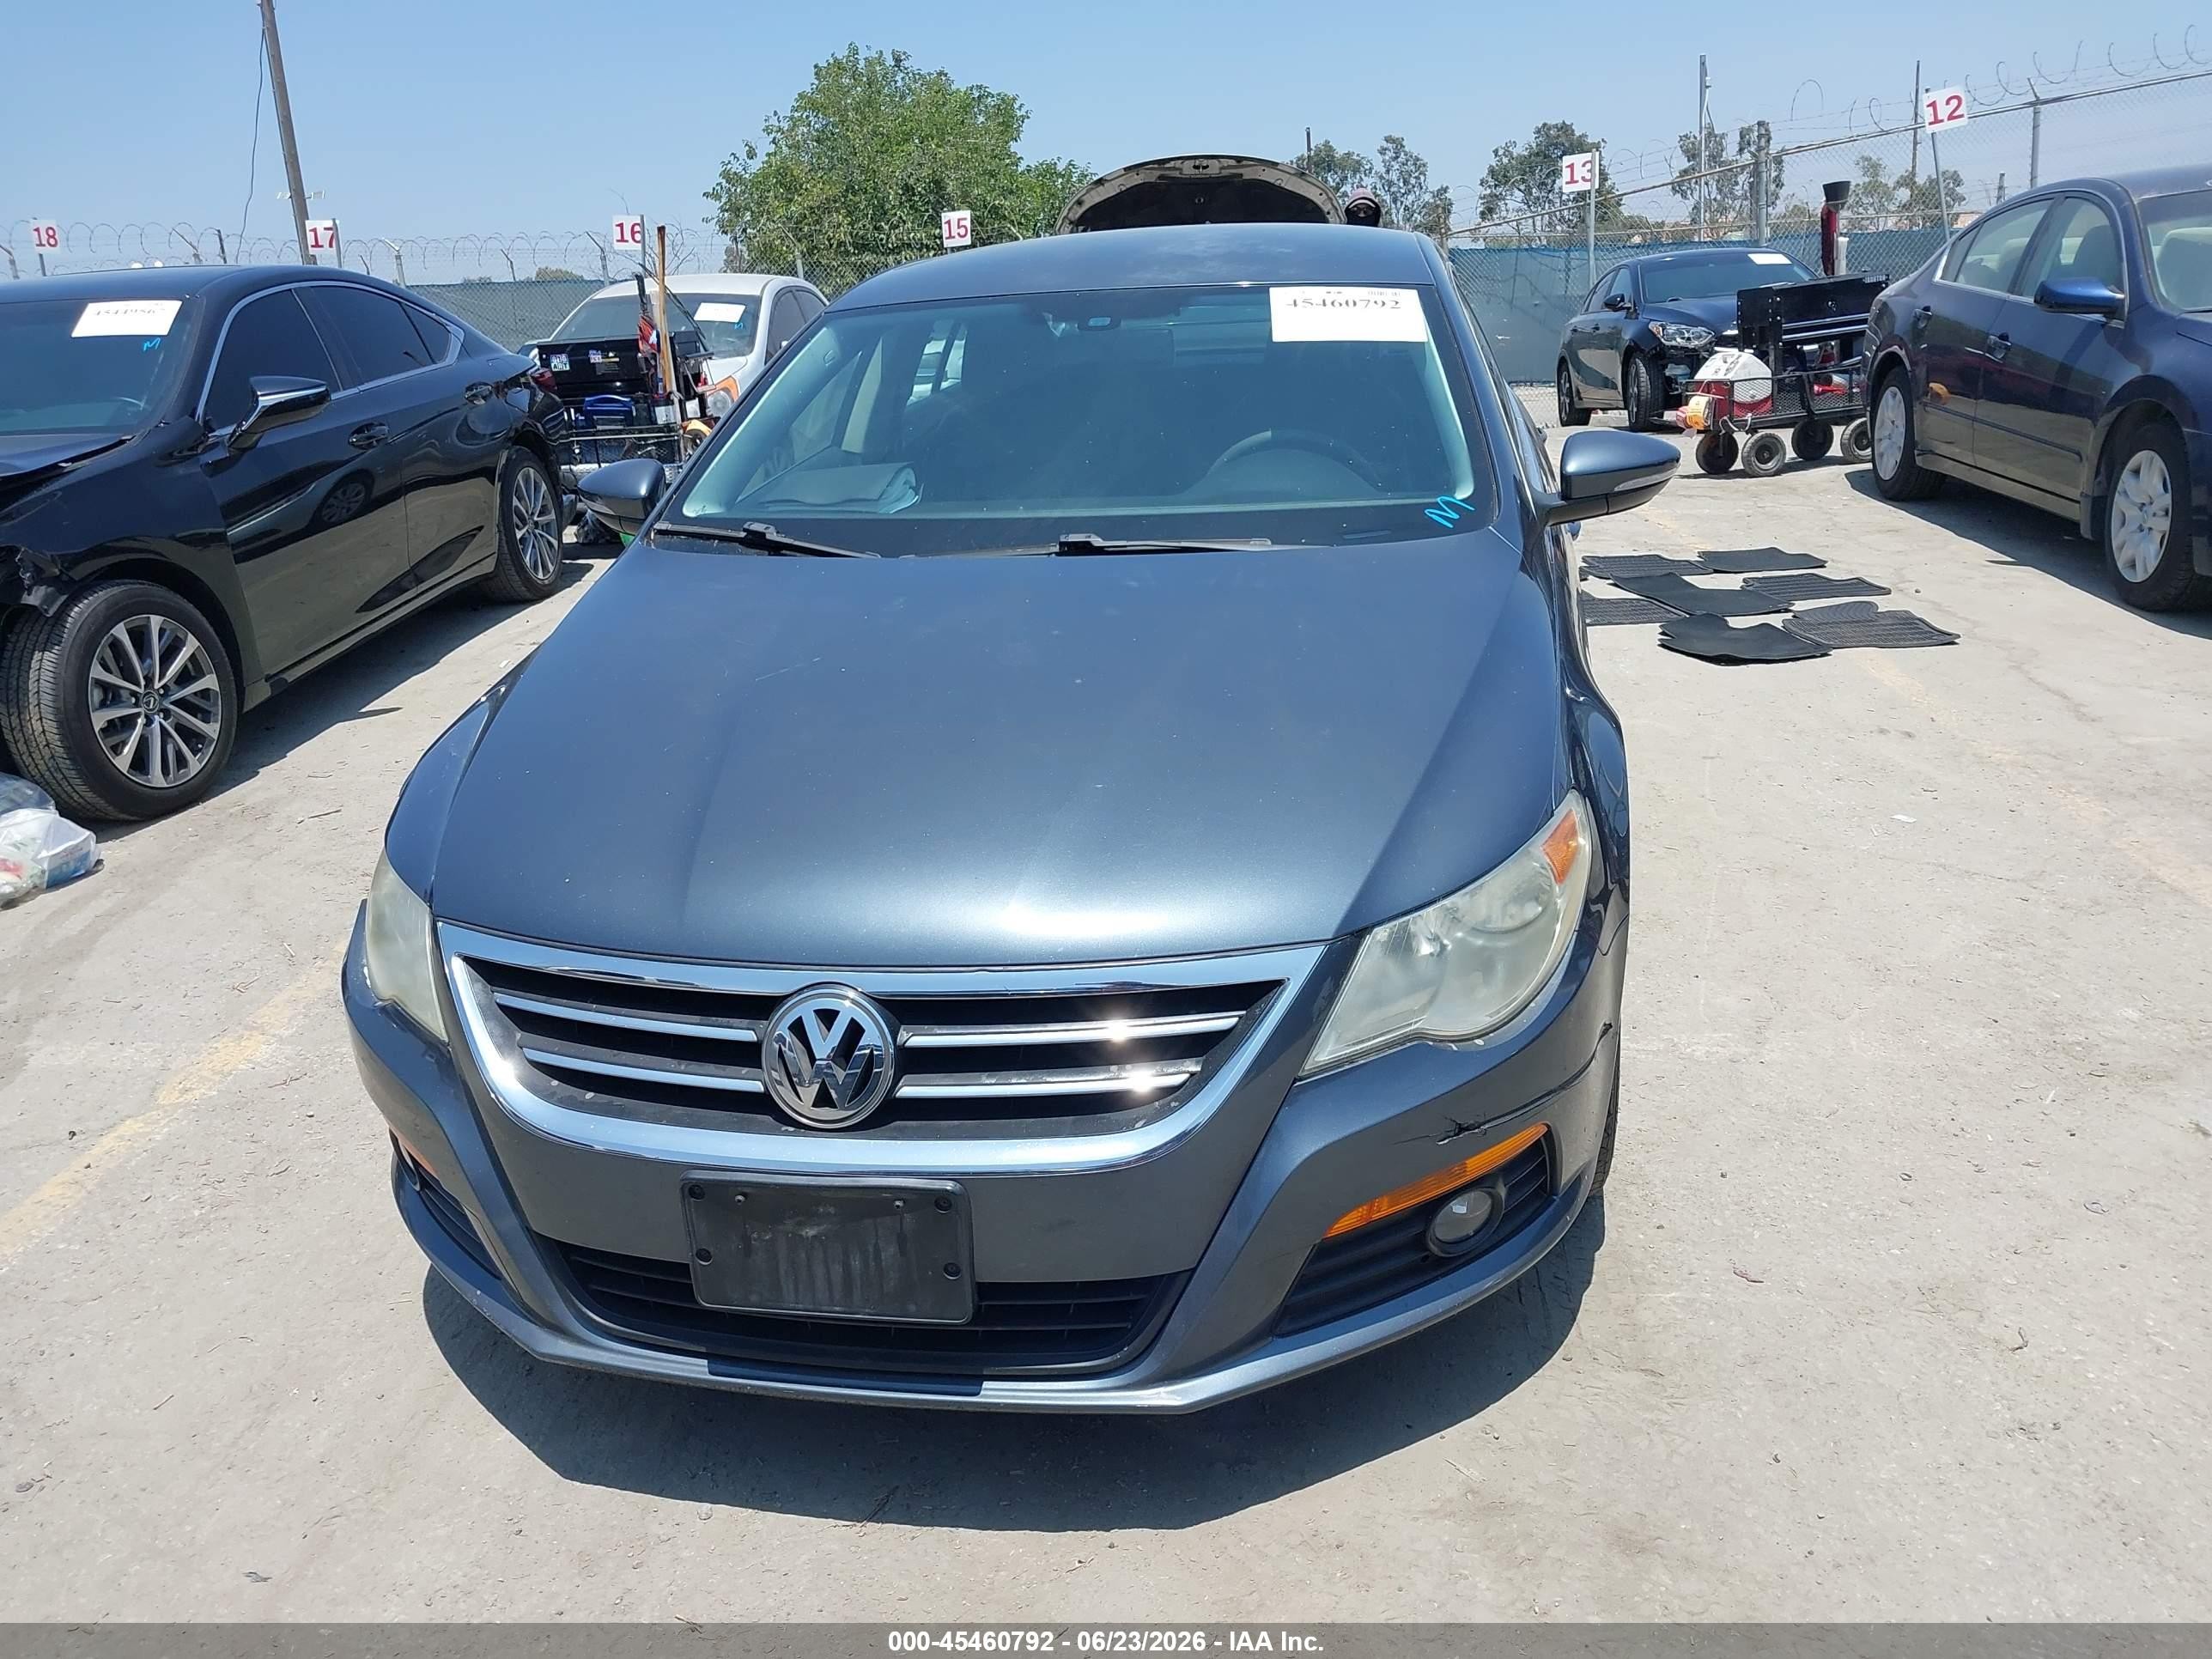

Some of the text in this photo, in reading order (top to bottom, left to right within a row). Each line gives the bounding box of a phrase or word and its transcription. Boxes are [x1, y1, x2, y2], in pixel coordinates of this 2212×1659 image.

[1926, 94, 1965, 126] 12
[1565, 160, 1592, 185] 13
[33, 226, 58, 247] 18
[308, 227, 335, 249] 17
[615, 222, 641, 244] 16
[944, 217, 969, 240] 15
[1286, 298, 1401, 309] 45460792
